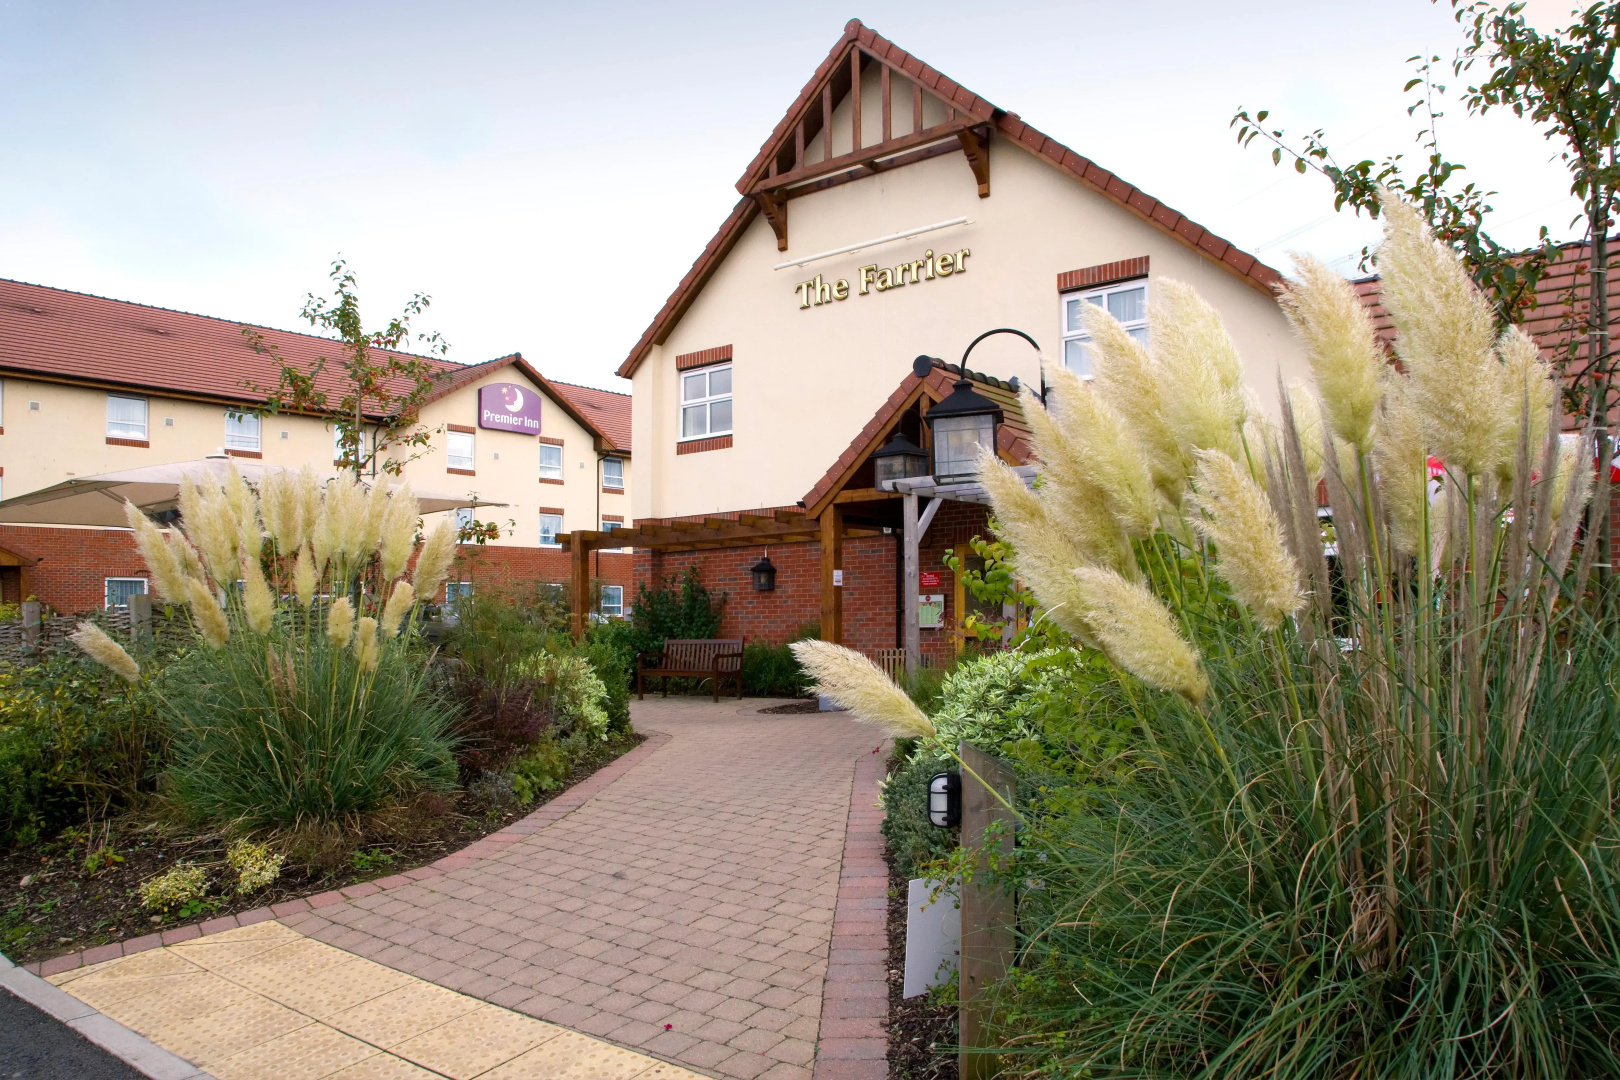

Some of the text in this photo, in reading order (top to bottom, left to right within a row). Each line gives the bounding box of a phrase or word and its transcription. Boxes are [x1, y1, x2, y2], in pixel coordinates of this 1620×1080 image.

[795, 248, 971, 310] The Farrier
[483, 409, 539, 429] Premier Inn
